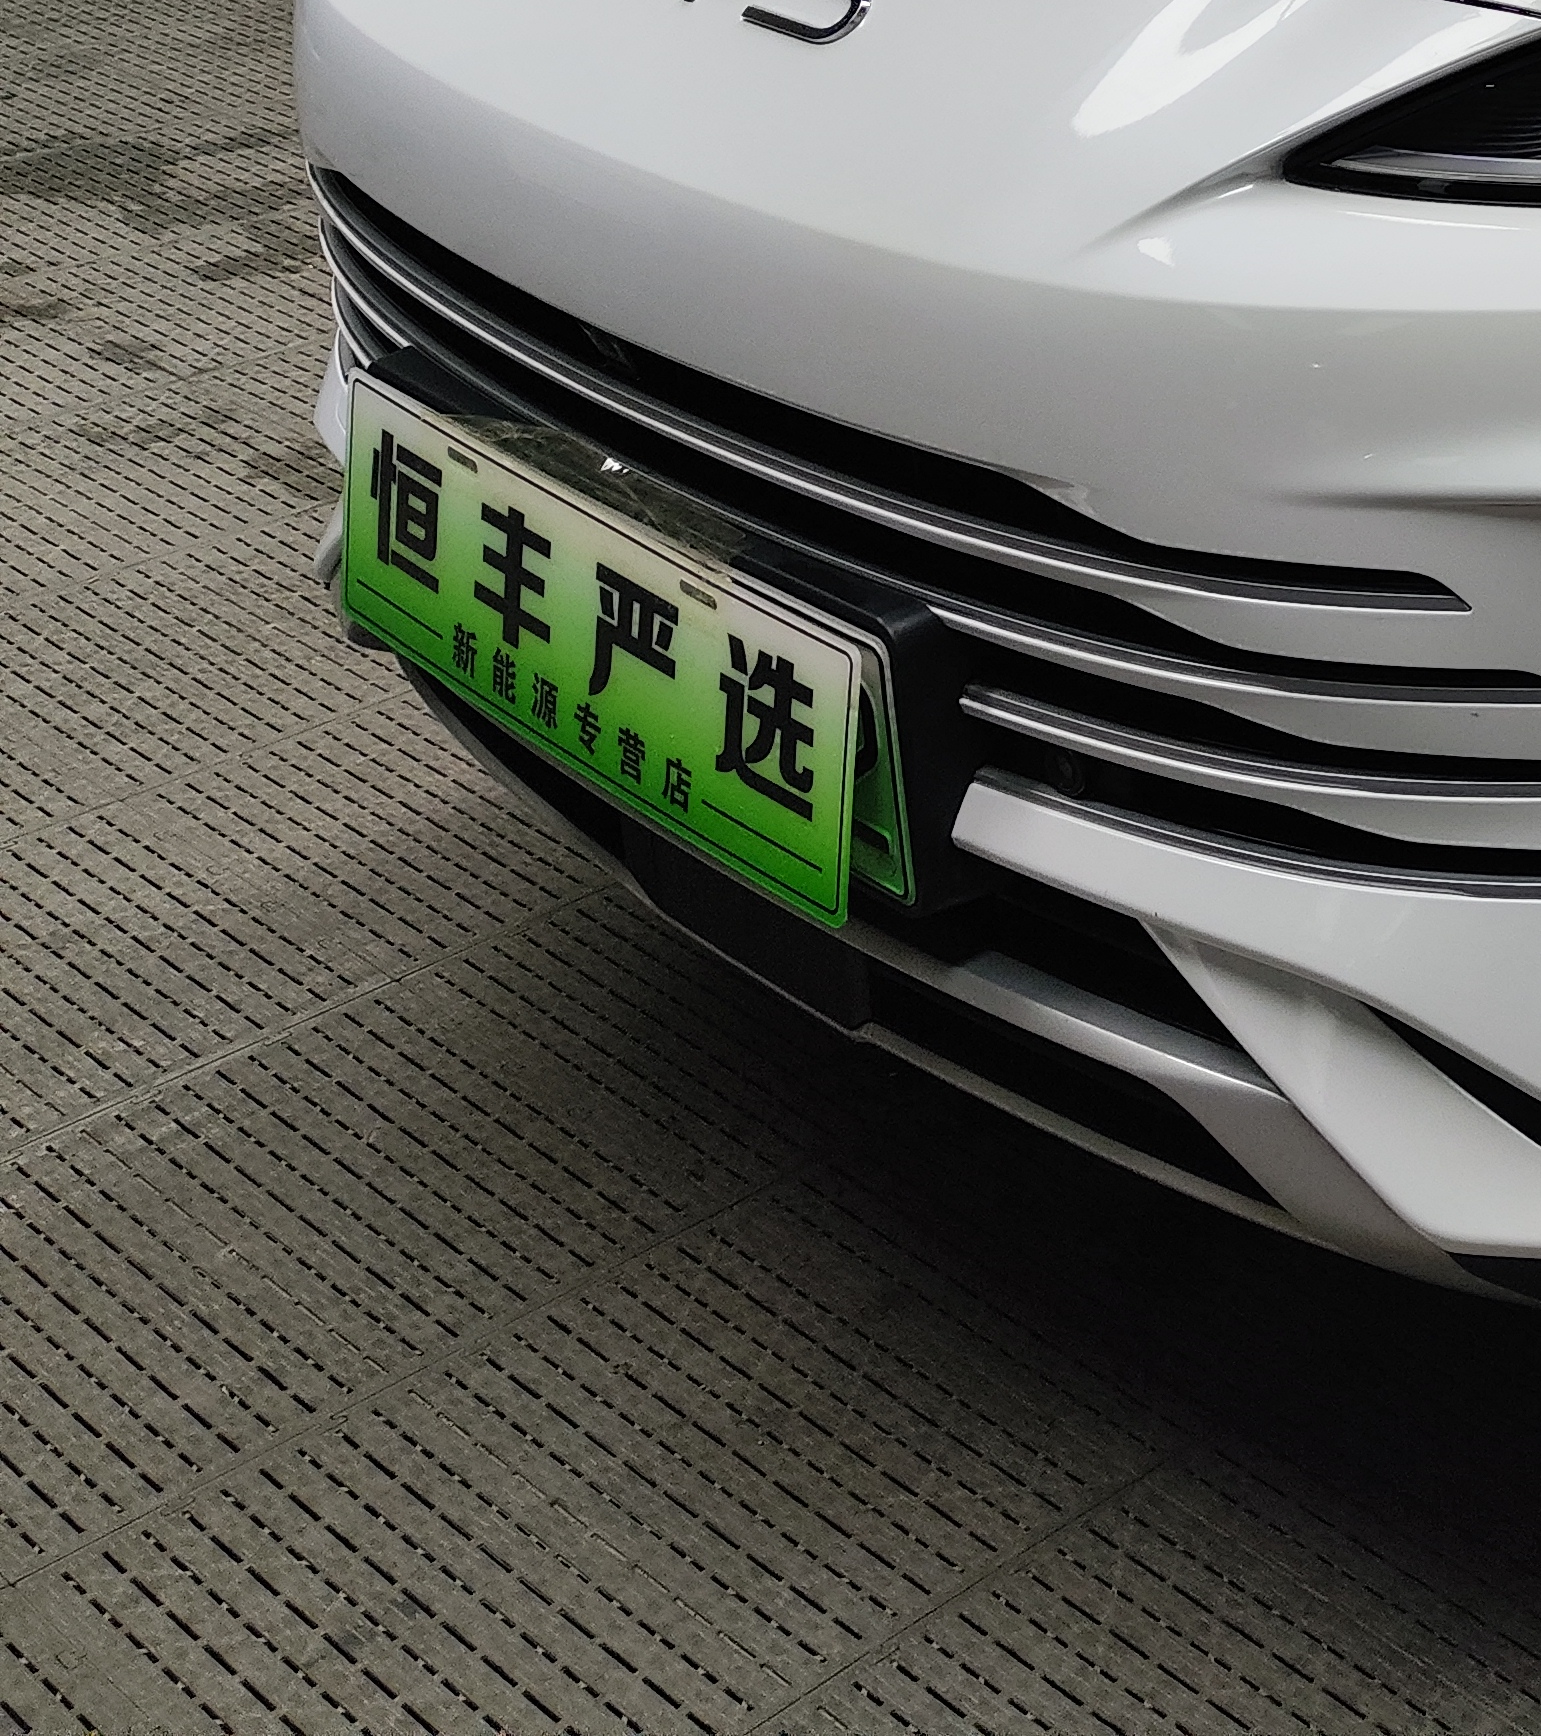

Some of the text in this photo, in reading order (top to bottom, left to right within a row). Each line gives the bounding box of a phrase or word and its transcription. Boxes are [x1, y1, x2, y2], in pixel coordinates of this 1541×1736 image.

[370, 428, 814, 823] 恒丰严选
[452, 622, 692, 814] 新能源专营店
